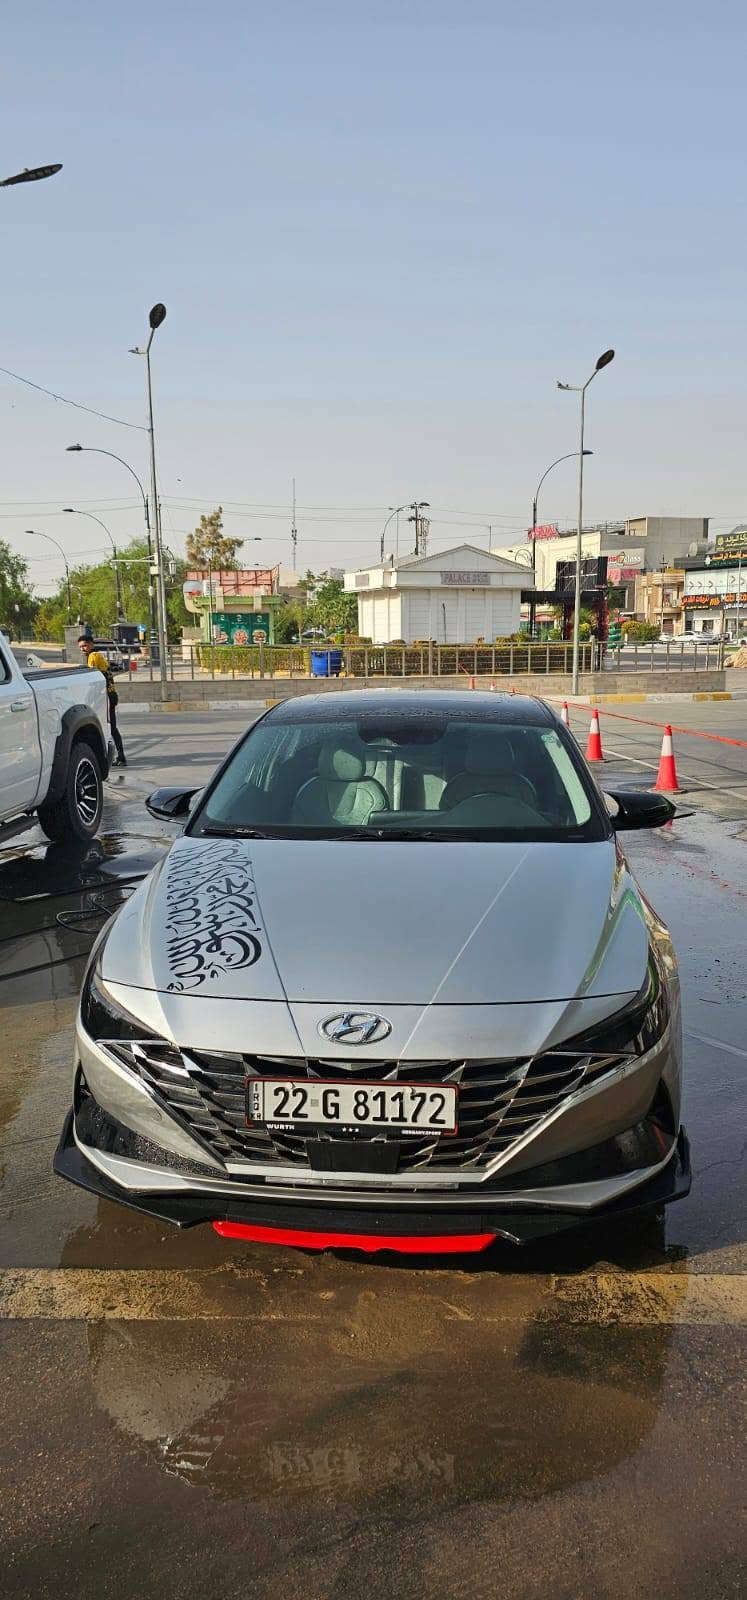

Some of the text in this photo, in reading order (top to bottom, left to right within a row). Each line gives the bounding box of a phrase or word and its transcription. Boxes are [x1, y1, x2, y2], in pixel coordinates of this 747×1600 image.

[273, 1086, 446, 1125] 22 G 81172
